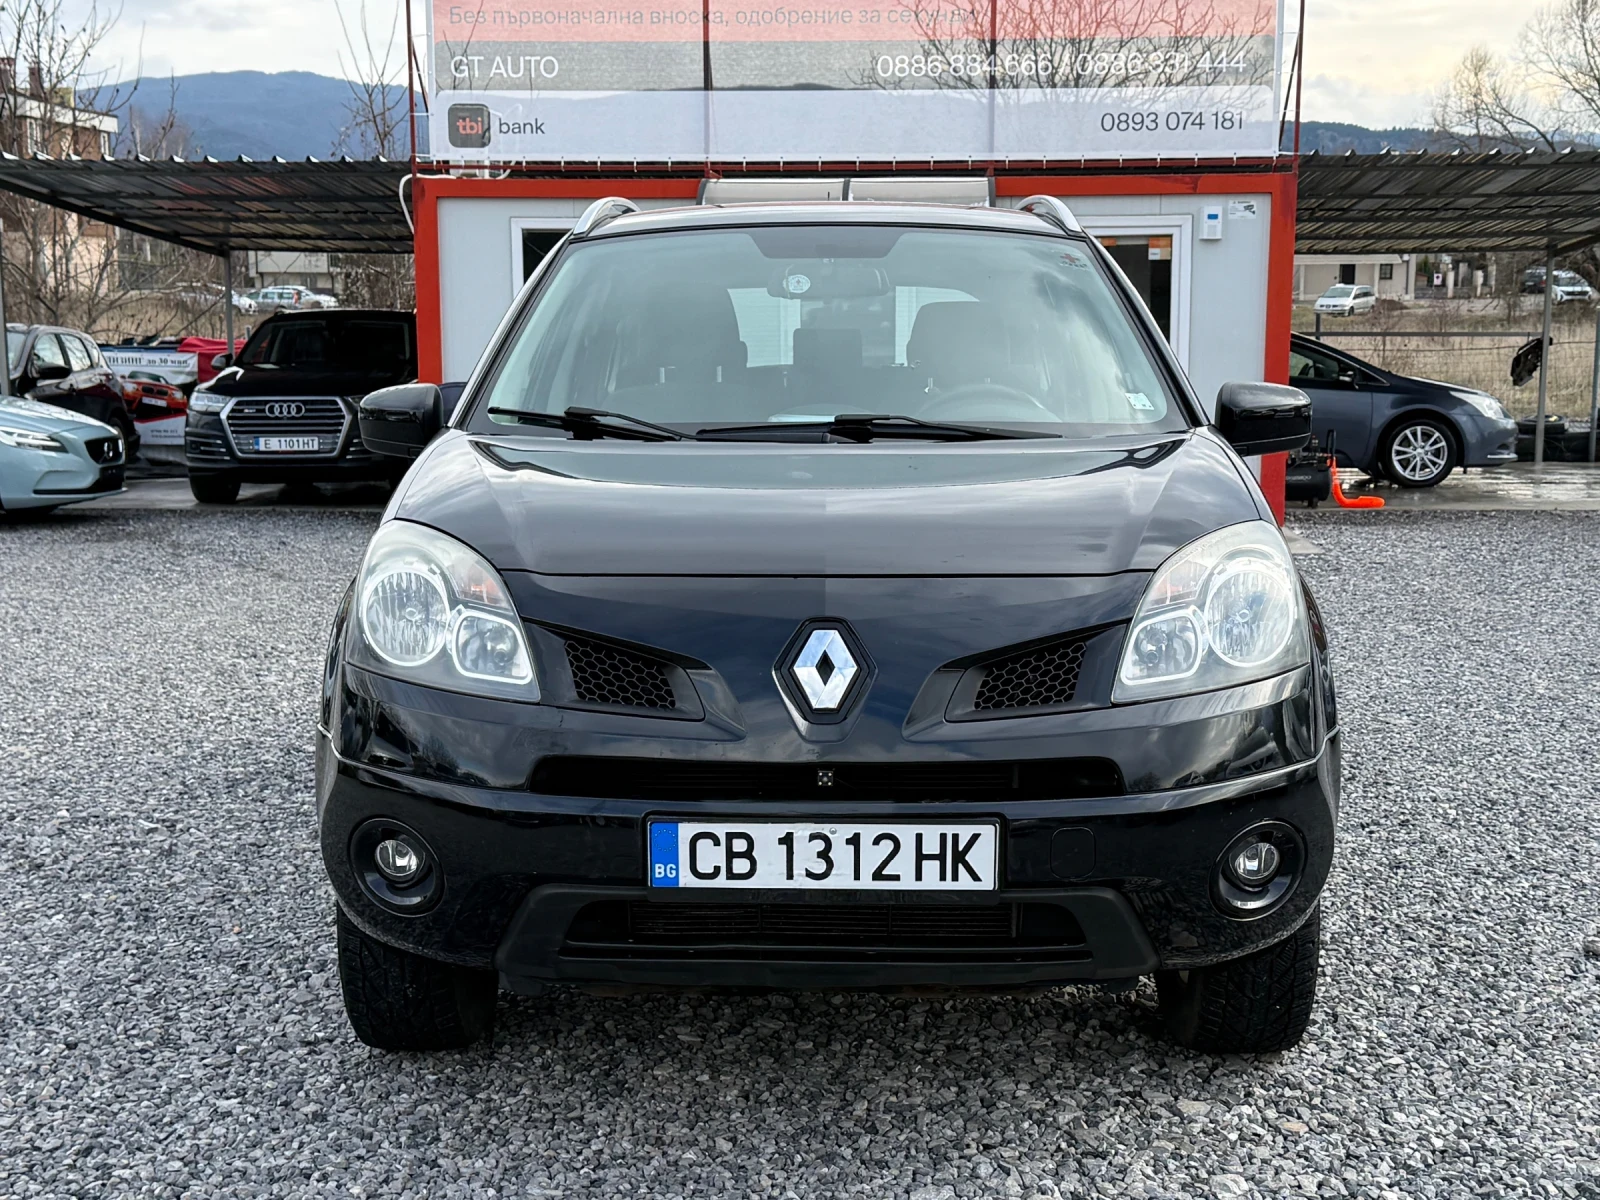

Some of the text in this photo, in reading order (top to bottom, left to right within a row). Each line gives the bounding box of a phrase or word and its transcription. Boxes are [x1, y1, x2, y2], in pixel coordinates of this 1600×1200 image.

[449, 6, 975, 28] Без първоначална вноска, одобрение за секунди
[450, 55, 559, 78] GT AUTO
[876, 54, 943, 77] 0886
[949, 53, 998, 76] 884
[1004, 53, 1053, 76] 666
[1075, 52, 1143, 75] 0886
[1148, 51, 1190, 74] 331
[1196, 50, 1247, 73] 444
[456, 116, 546, 135] tbi bank
[1100, 110, 1243, 132] 0893 074 181
[264, 438, 272, 450] E
[277, 438, 301, 450] 1101
[302, 438, 316, 450] HT
[688, 831, 983, 882] CB 1312 HK
[654, 864, 677, 878] BG
